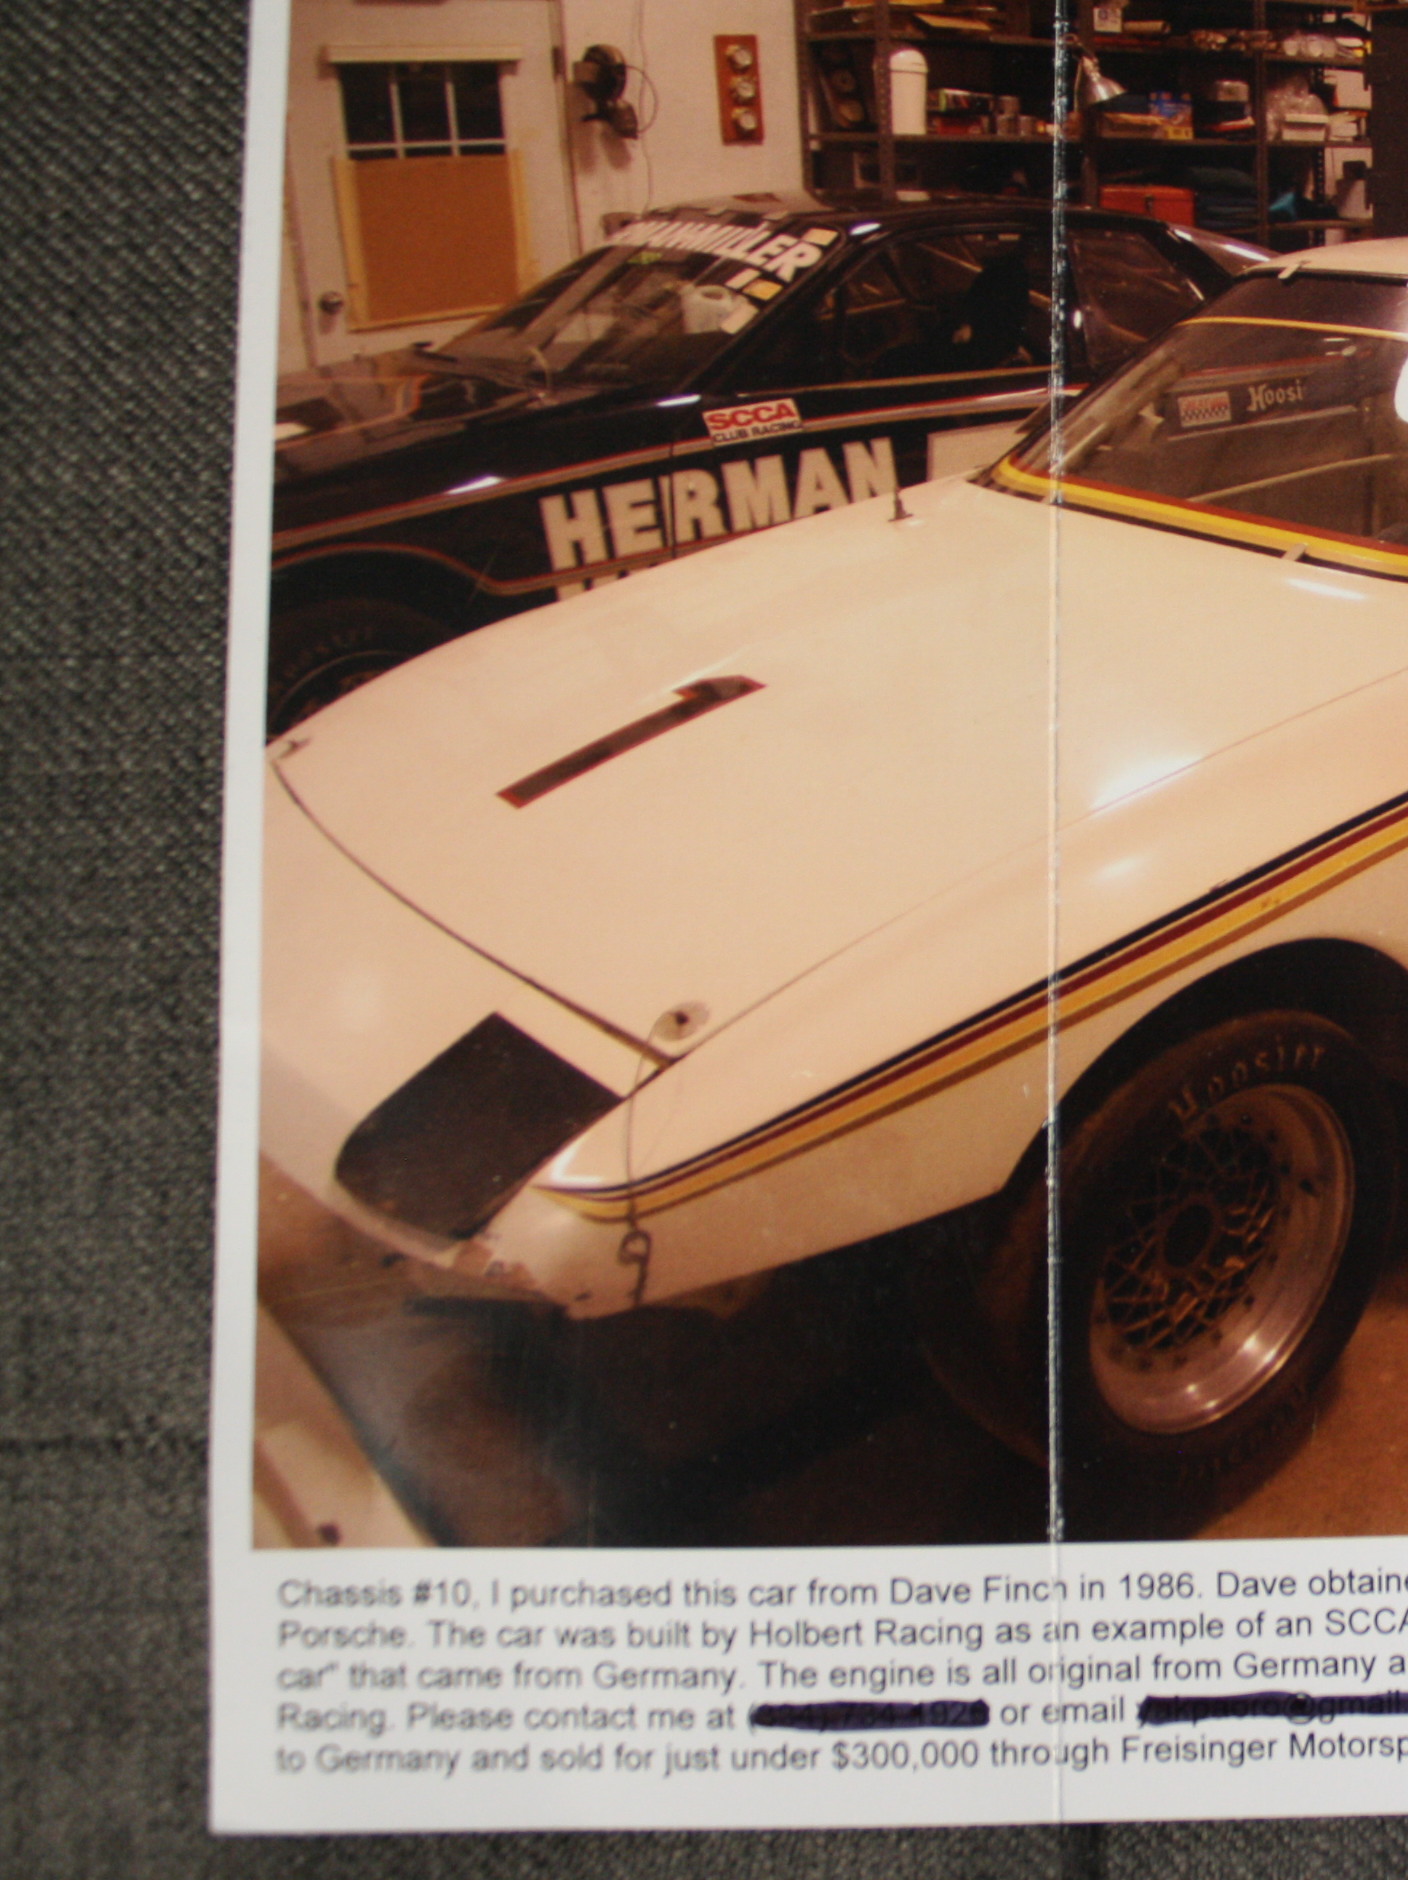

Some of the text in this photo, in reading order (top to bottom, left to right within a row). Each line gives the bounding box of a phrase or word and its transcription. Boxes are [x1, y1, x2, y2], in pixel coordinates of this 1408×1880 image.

[706, 402, 797, 432] SCCA
[712, 420, 802, 444] CLUB RACING
[539, 436, 901, 570] HERMAN
[495, 674, 769, 810] 1
[277, 1578, 403, 1608] Chassis
[412, 1577, 480, 1611] #10,
[491, 1578, 499, 1605] I
[510, 1579, 673, 1612] purchased
[682, 1578, 738, 1607] this
[747, 1583, 798, 1607] car
[806, 1576, 879, 1606] from
[889, 1575, 972, 1605] Dave
[983, 1574, 1068, 1603] Finch
[1079, 1572, 1106, 1601] in
[1119, 1570, 1203, 1600] 1986.
[1216, 1569, 1298, 1599] Dave
[278, 1619, 415, 1649] Porsche.
[428, 1618, 487, 1648] The
[496, 1625, 545, 1649] car
[554, 1625, 617, 1648] was
[626, 1620, 691, 1649] built
[701, 1620, 738, 1655] by
[749, 1619, 864, 1648] Holbert
[874, 1617, 984, 1652] Racing
[994, 1620, 1032, 1645] as
[1042, 1619, 1081, 1643] an
[1090, 1611, 1225, 1647] example
[1235, 1608, 1266, 1639] of
[1274, 1614, 1313, 1638] an
[276, 1661, 339, 1690] car"
[348, 1662, 407, 1689] that
[417, 1666, 503, 1690] came
[512, 1660, 583, 1689] from
[592, 1660, 745, 1696] Germany.
[757, 1658, 819, 1689] The
[828, 1659, 936, 1695] engine
[946, 1658, 972, 1687] is
[981, 1656, 1017, 1686] all
[1027, 1653, 1141, 1691] original
[1151, 1652, 1222, 1681] from
[1232, 1650, 1378, 1690] Germany
[407, 1700, 515, 1731] Please
[523, 1703, 637, 1731] contact
[647, 1707, 696, 1730] me
[706, 1703, 736, 1731] at
[999, 1702, 1031, 1726] or
[1040, 1693, 1126, 1725] email
[275, 1747, 306, 1773] to
[315, 1742, 461, 1778] Germany
[471, 1743, 530, 1772] and
[540, 1743, 604, 1771] sold
[614, 1742, 654, 1772] for
[663, 1744, 720, 1778] just
[730, 1742, 821, 1771] under
[831, 1738, 980, 1772] $300,000
[989, 1735, 1110, 1772] through
[1121, 1733, 1278, 1769] Freisinger
